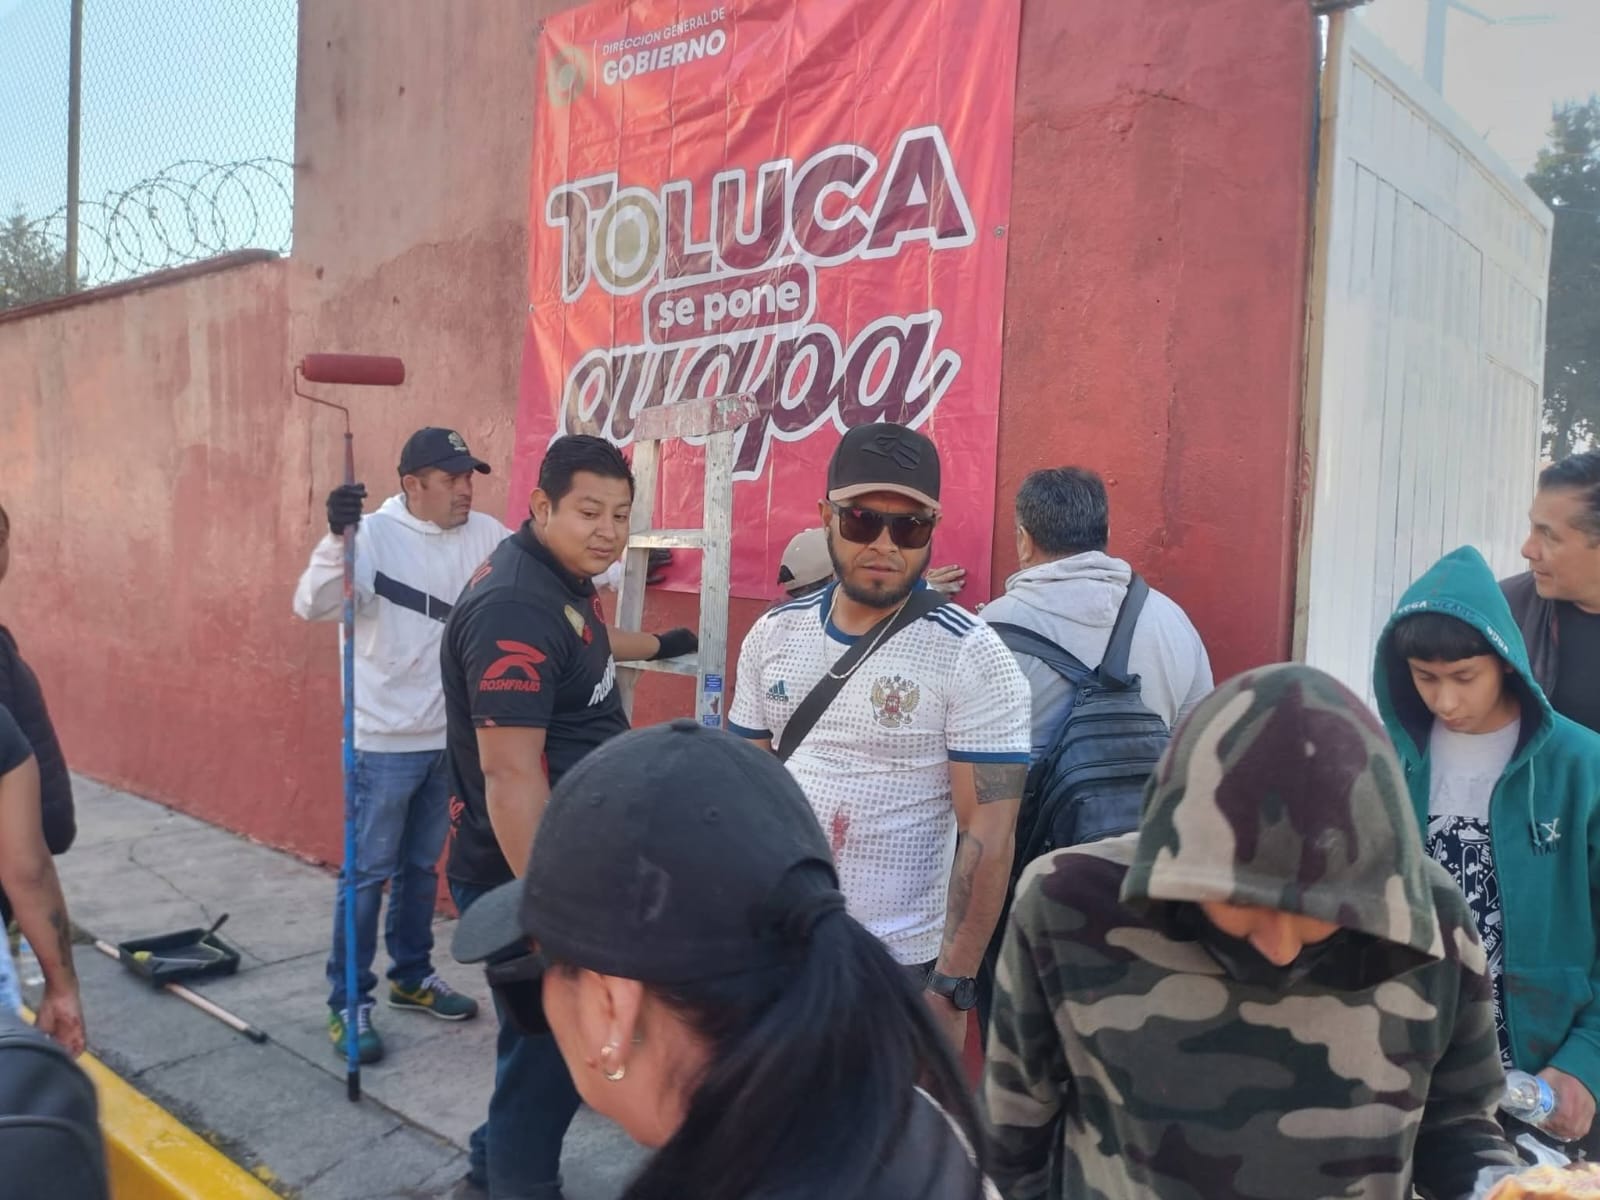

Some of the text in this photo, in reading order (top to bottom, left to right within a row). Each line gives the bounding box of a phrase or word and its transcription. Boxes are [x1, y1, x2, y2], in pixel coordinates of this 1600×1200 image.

[663, 13, 709, 39] GENERAL
[710, 7, 726, 23] DE
[603, 29, 726, 85] GOBIERNO
[546, 125, 976, 303] TOLUCA
[659, 280, 801, 331] se pone
